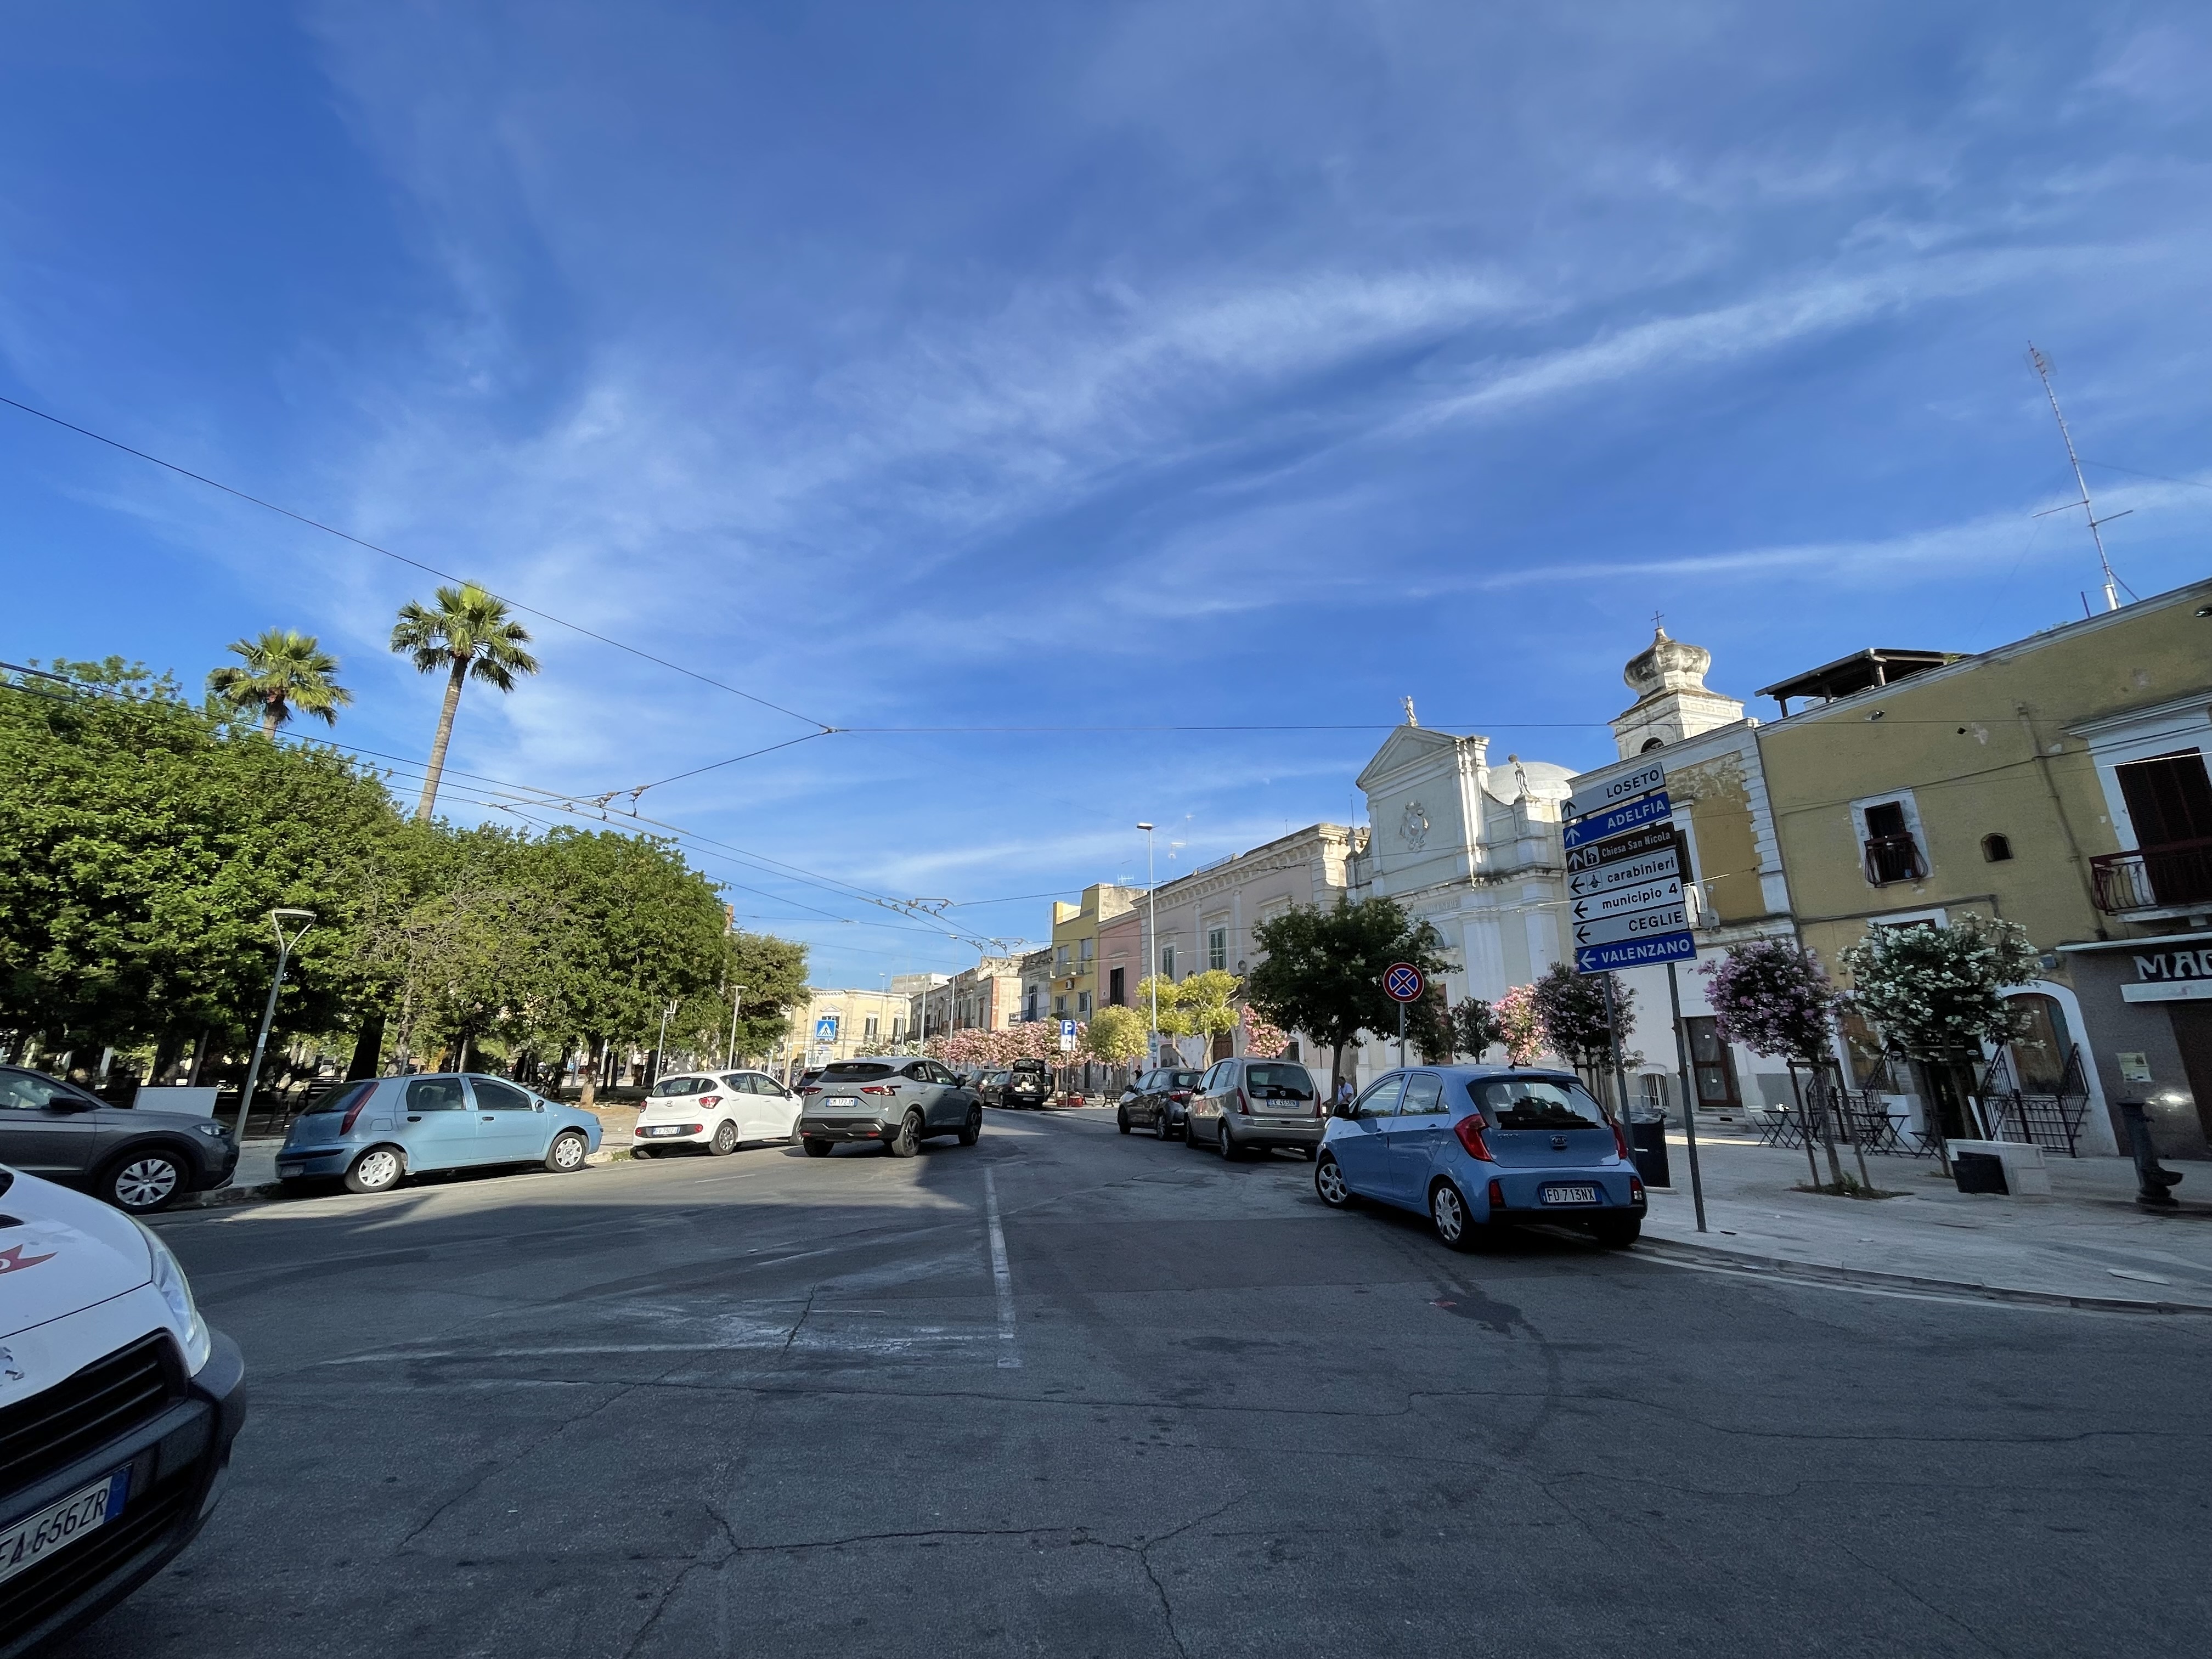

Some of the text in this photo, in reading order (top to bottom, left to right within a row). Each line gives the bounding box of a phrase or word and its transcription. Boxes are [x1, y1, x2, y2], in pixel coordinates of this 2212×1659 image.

[1606, 769, 1660, 798] LOSETO
[1607, 800, 1666, 830] ADELFIA
[1602, 832, 1671, 857] Chiesa San Nicola
[1607, 856, 1675, 883] carabinieri
[1602, 883, 1678, 910] municipio 4
[1628, 911, 1683, 932] CEGLIE
[1601, 939, 1690, 963] VALENZANO
[1065, 1022, 1073, 1034] P
[1547, 1189, 1559, 1201] FD
[1562, 1188, 1595, 1201] 713NX
[32, 1488, 108, 1554] 656ZR
